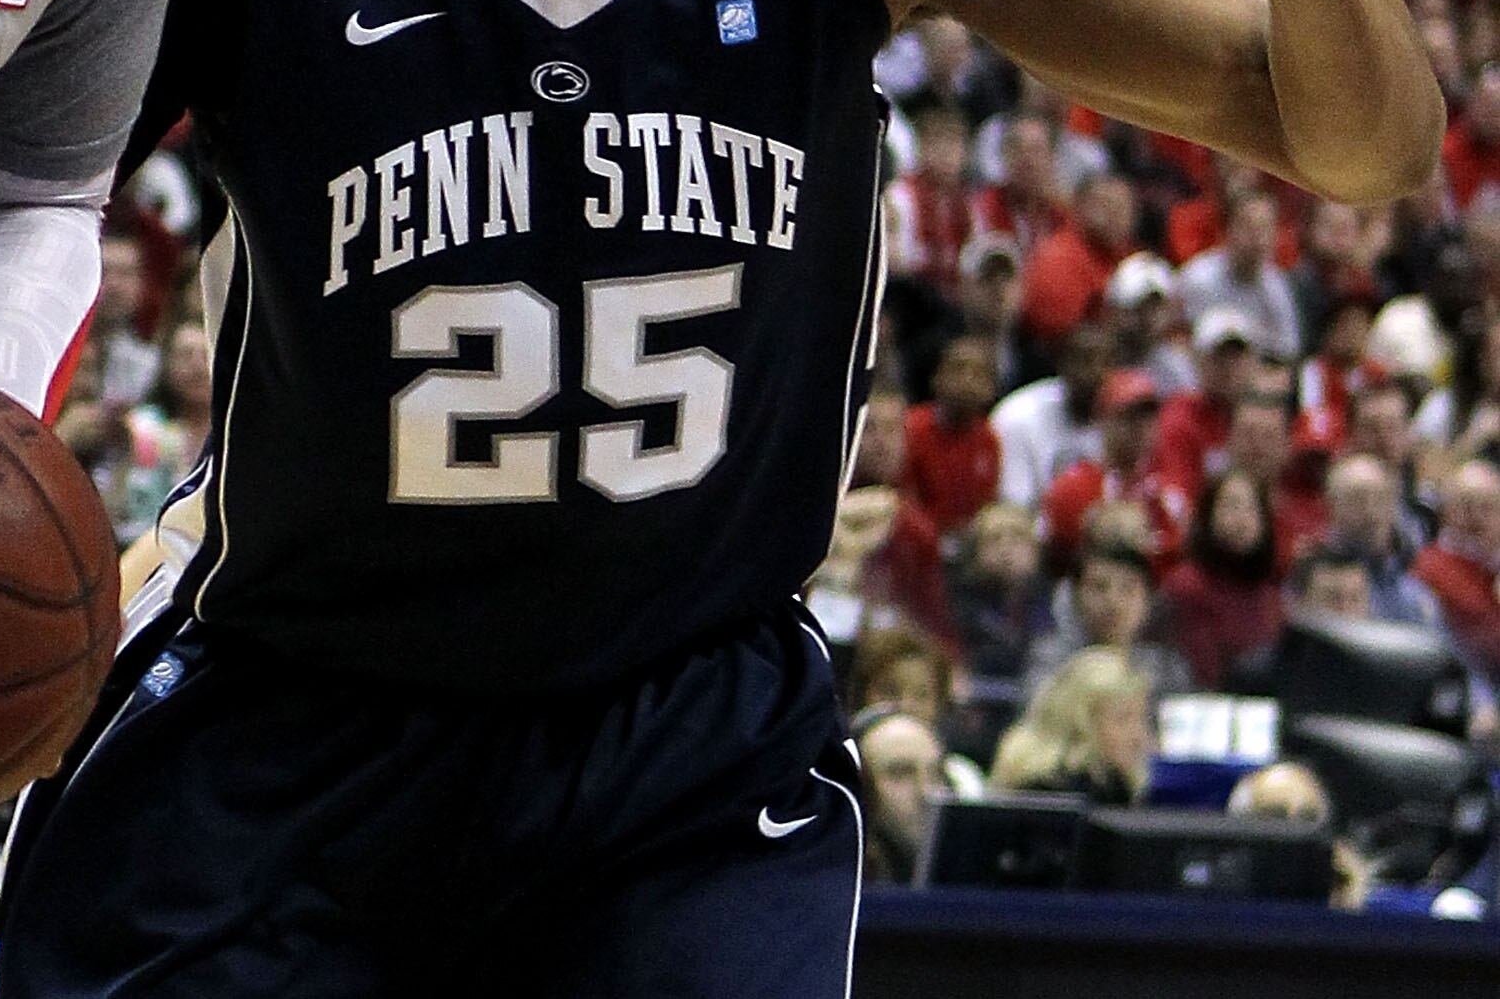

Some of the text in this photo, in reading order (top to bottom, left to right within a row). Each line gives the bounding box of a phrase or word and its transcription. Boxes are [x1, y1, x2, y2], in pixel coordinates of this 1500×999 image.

[323, 111, 804, 297] PENN STATE
[387, 262, 744, 505] 25
